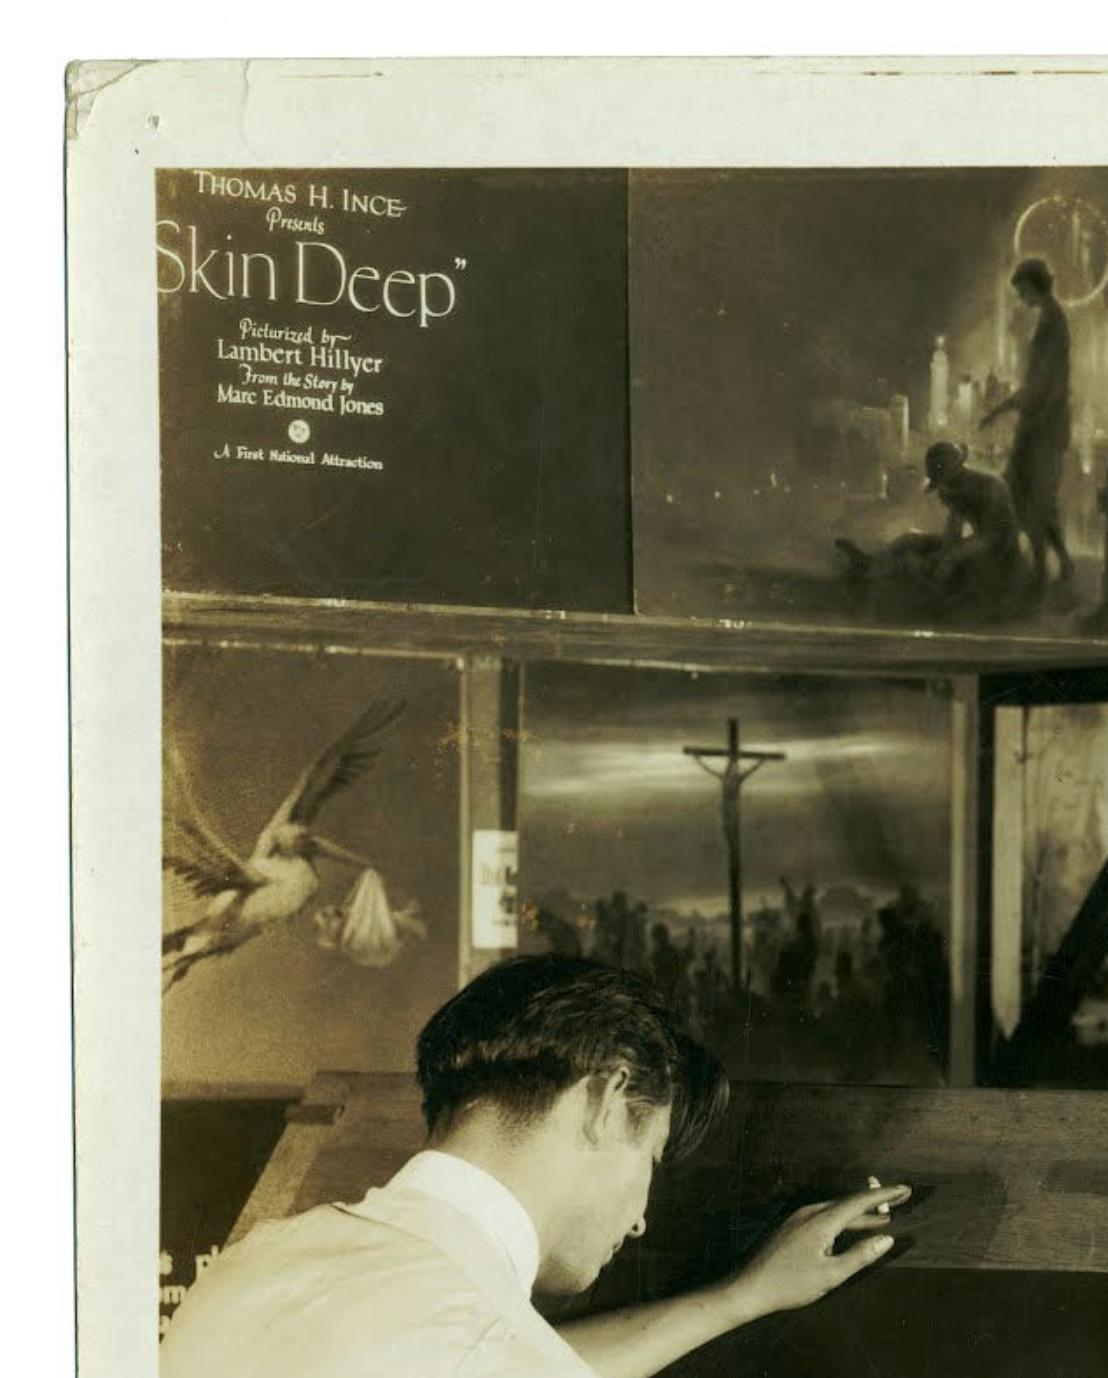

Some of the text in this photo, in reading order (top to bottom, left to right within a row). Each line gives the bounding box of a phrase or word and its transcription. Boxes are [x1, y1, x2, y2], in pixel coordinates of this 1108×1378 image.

[194, 170, 407, 218] THOMAS H. INCE
[266, 206, 325, 236] Presents
[156, 219, 278, 301] Skin
[239, 317, 353, 349] Picturized by
[217, 338, 384, 377] Lambert Hillyer
[239, 363, 355, 395] From the Story by
[217, 383, 385, 416] Marc Edmond Jones
[213, 443, 384, 471] A First National Attraction
